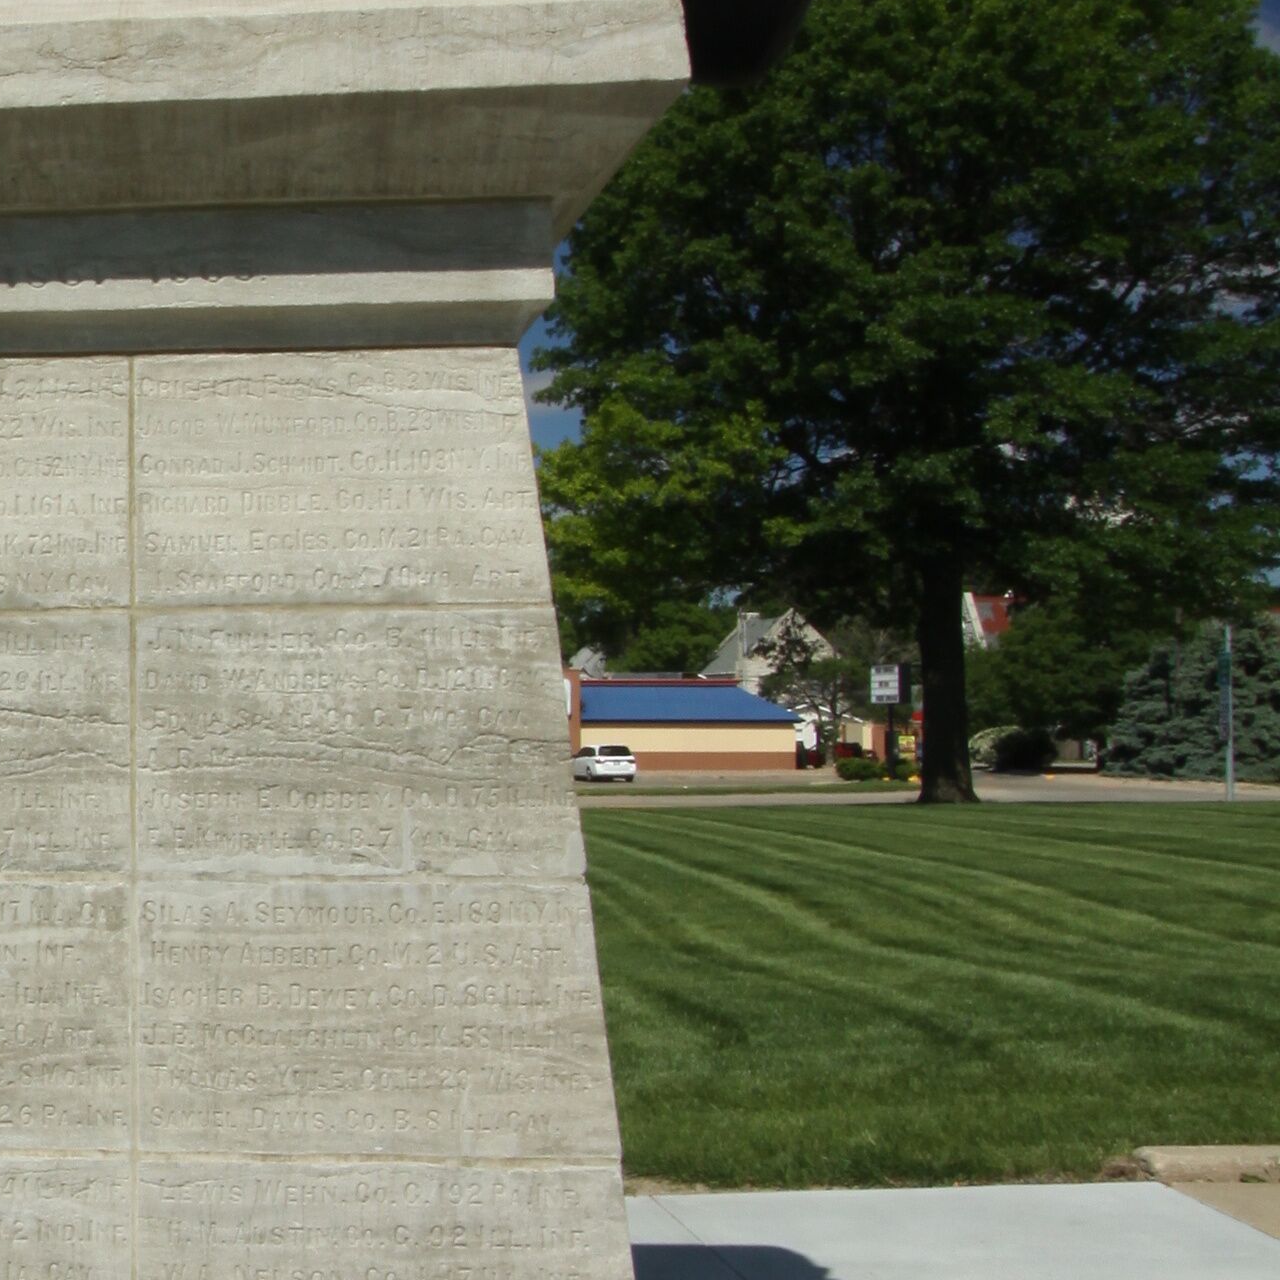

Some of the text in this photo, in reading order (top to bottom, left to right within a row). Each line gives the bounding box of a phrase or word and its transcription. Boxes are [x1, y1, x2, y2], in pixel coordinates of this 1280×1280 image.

[138, 491, 229, 513] RICHARD
[141, 899, 213, 924] SILAS
[151, 940, 230, 963] HENRY
[150, 1106, 238, 1129] SAMUEL
